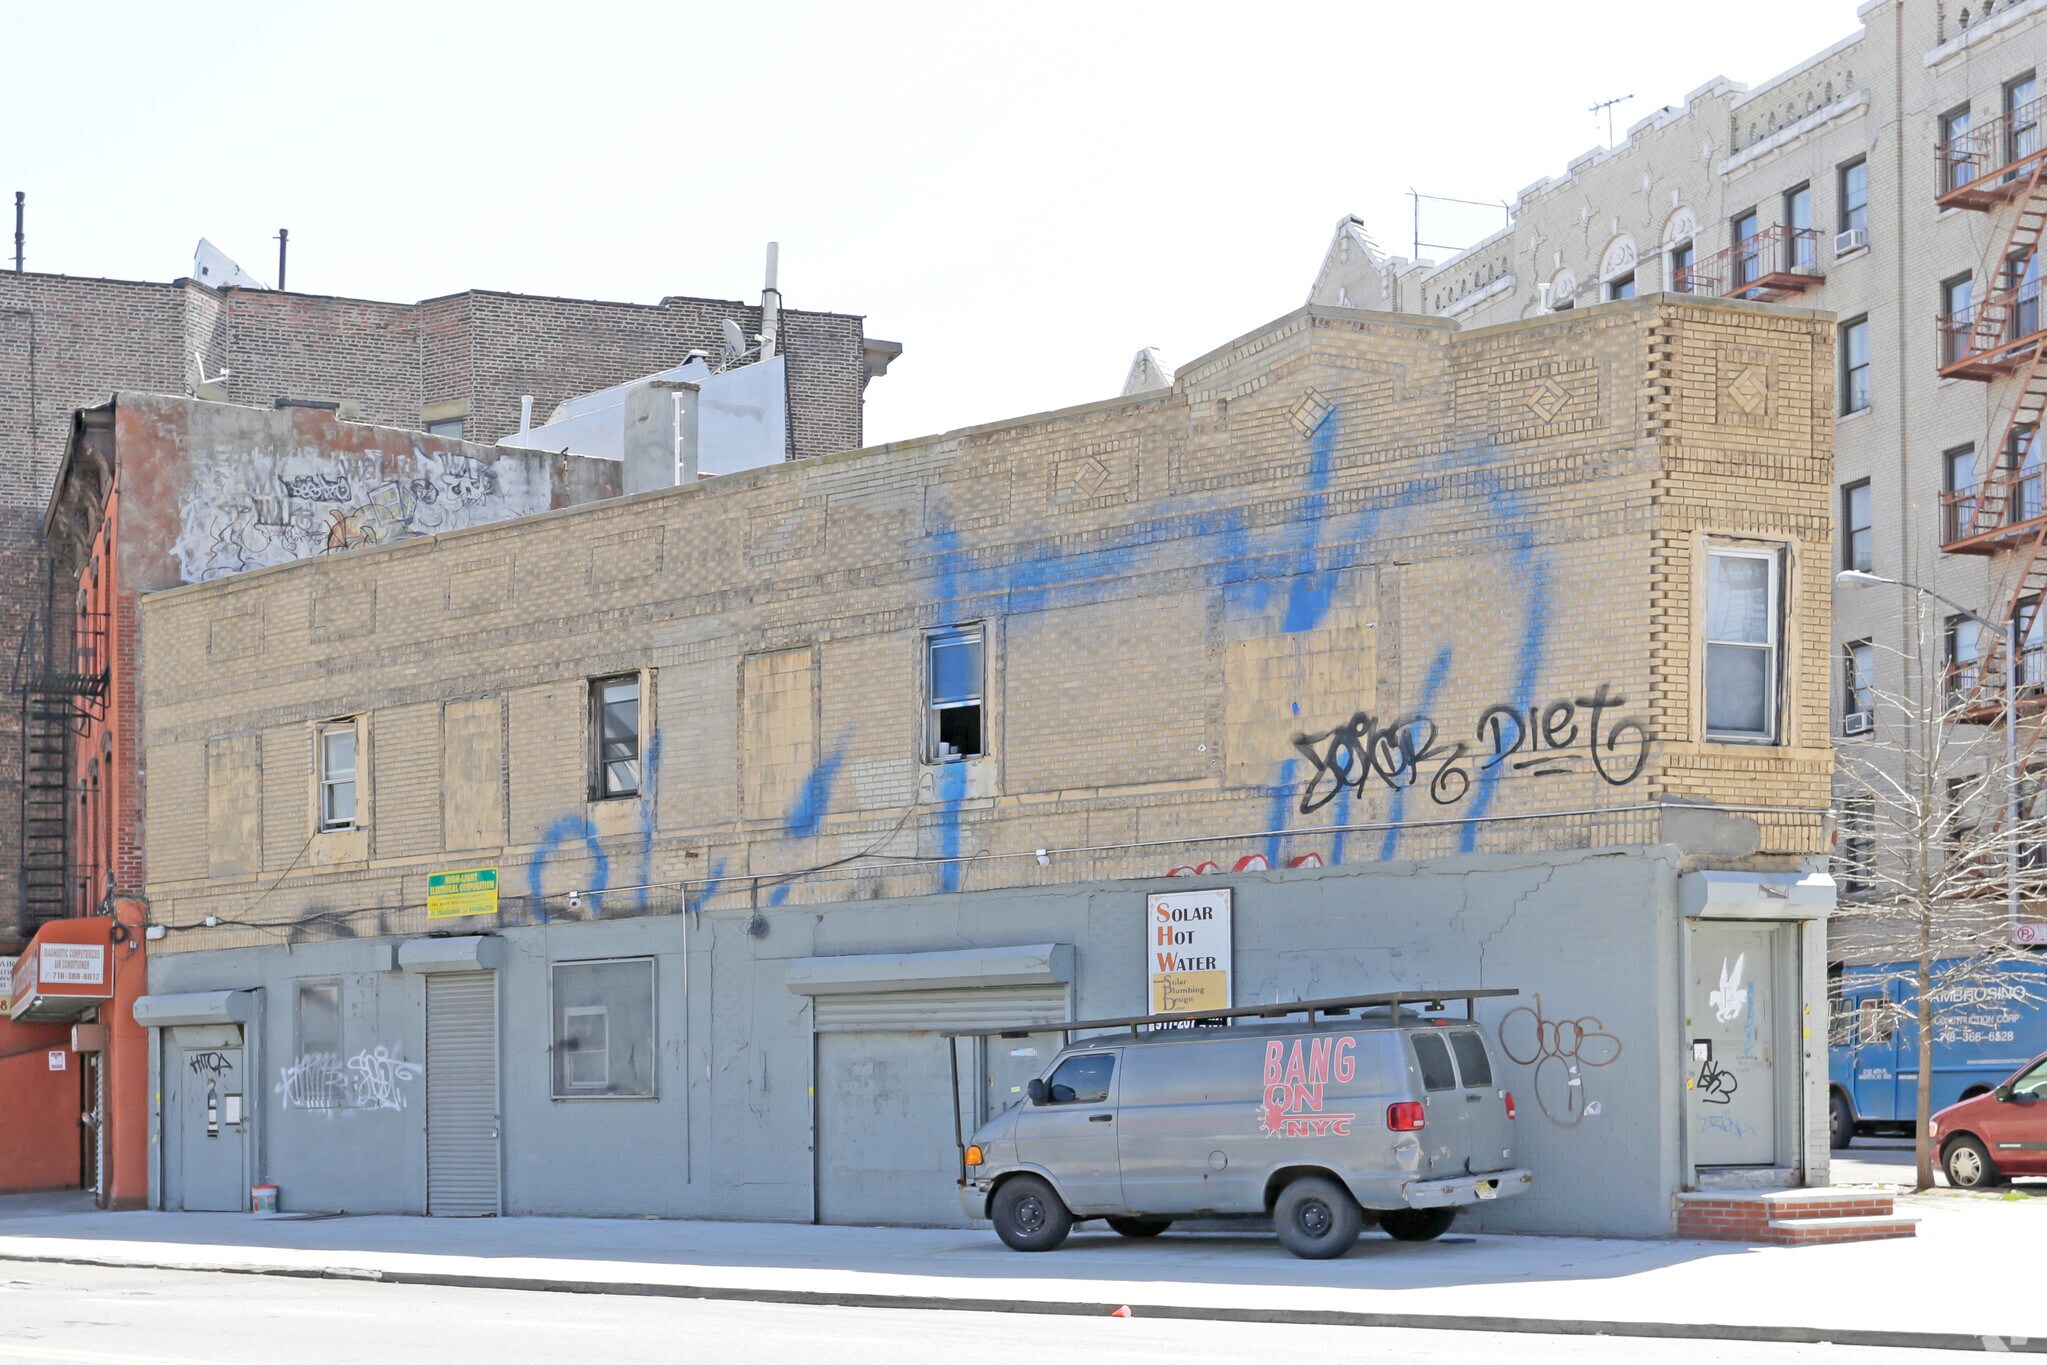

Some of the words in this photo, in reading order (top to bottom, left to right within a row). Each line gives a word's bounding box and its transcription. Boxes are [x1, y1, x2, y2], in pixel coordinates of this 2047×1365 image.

[44, 948, 68, 959] DIAGNOSTIC
[69, 948, 100, 960] COMPUTERIZED
[62, 960, 90, 970] CONDITIONER
[1163, 974, 1187, 988] Solar
[1163, 984, 1205, 996] Plumbing
[1930, 985, 2026, 1003] AMBROSINO
[1934, 1014, 1994, 1025] CONSTRUCTION
[1263, 1036, 1357, 1086] BANG
[1263, 1083, 1323, 1113] ON
[1286, 1119, 1351, 1137] NYC
